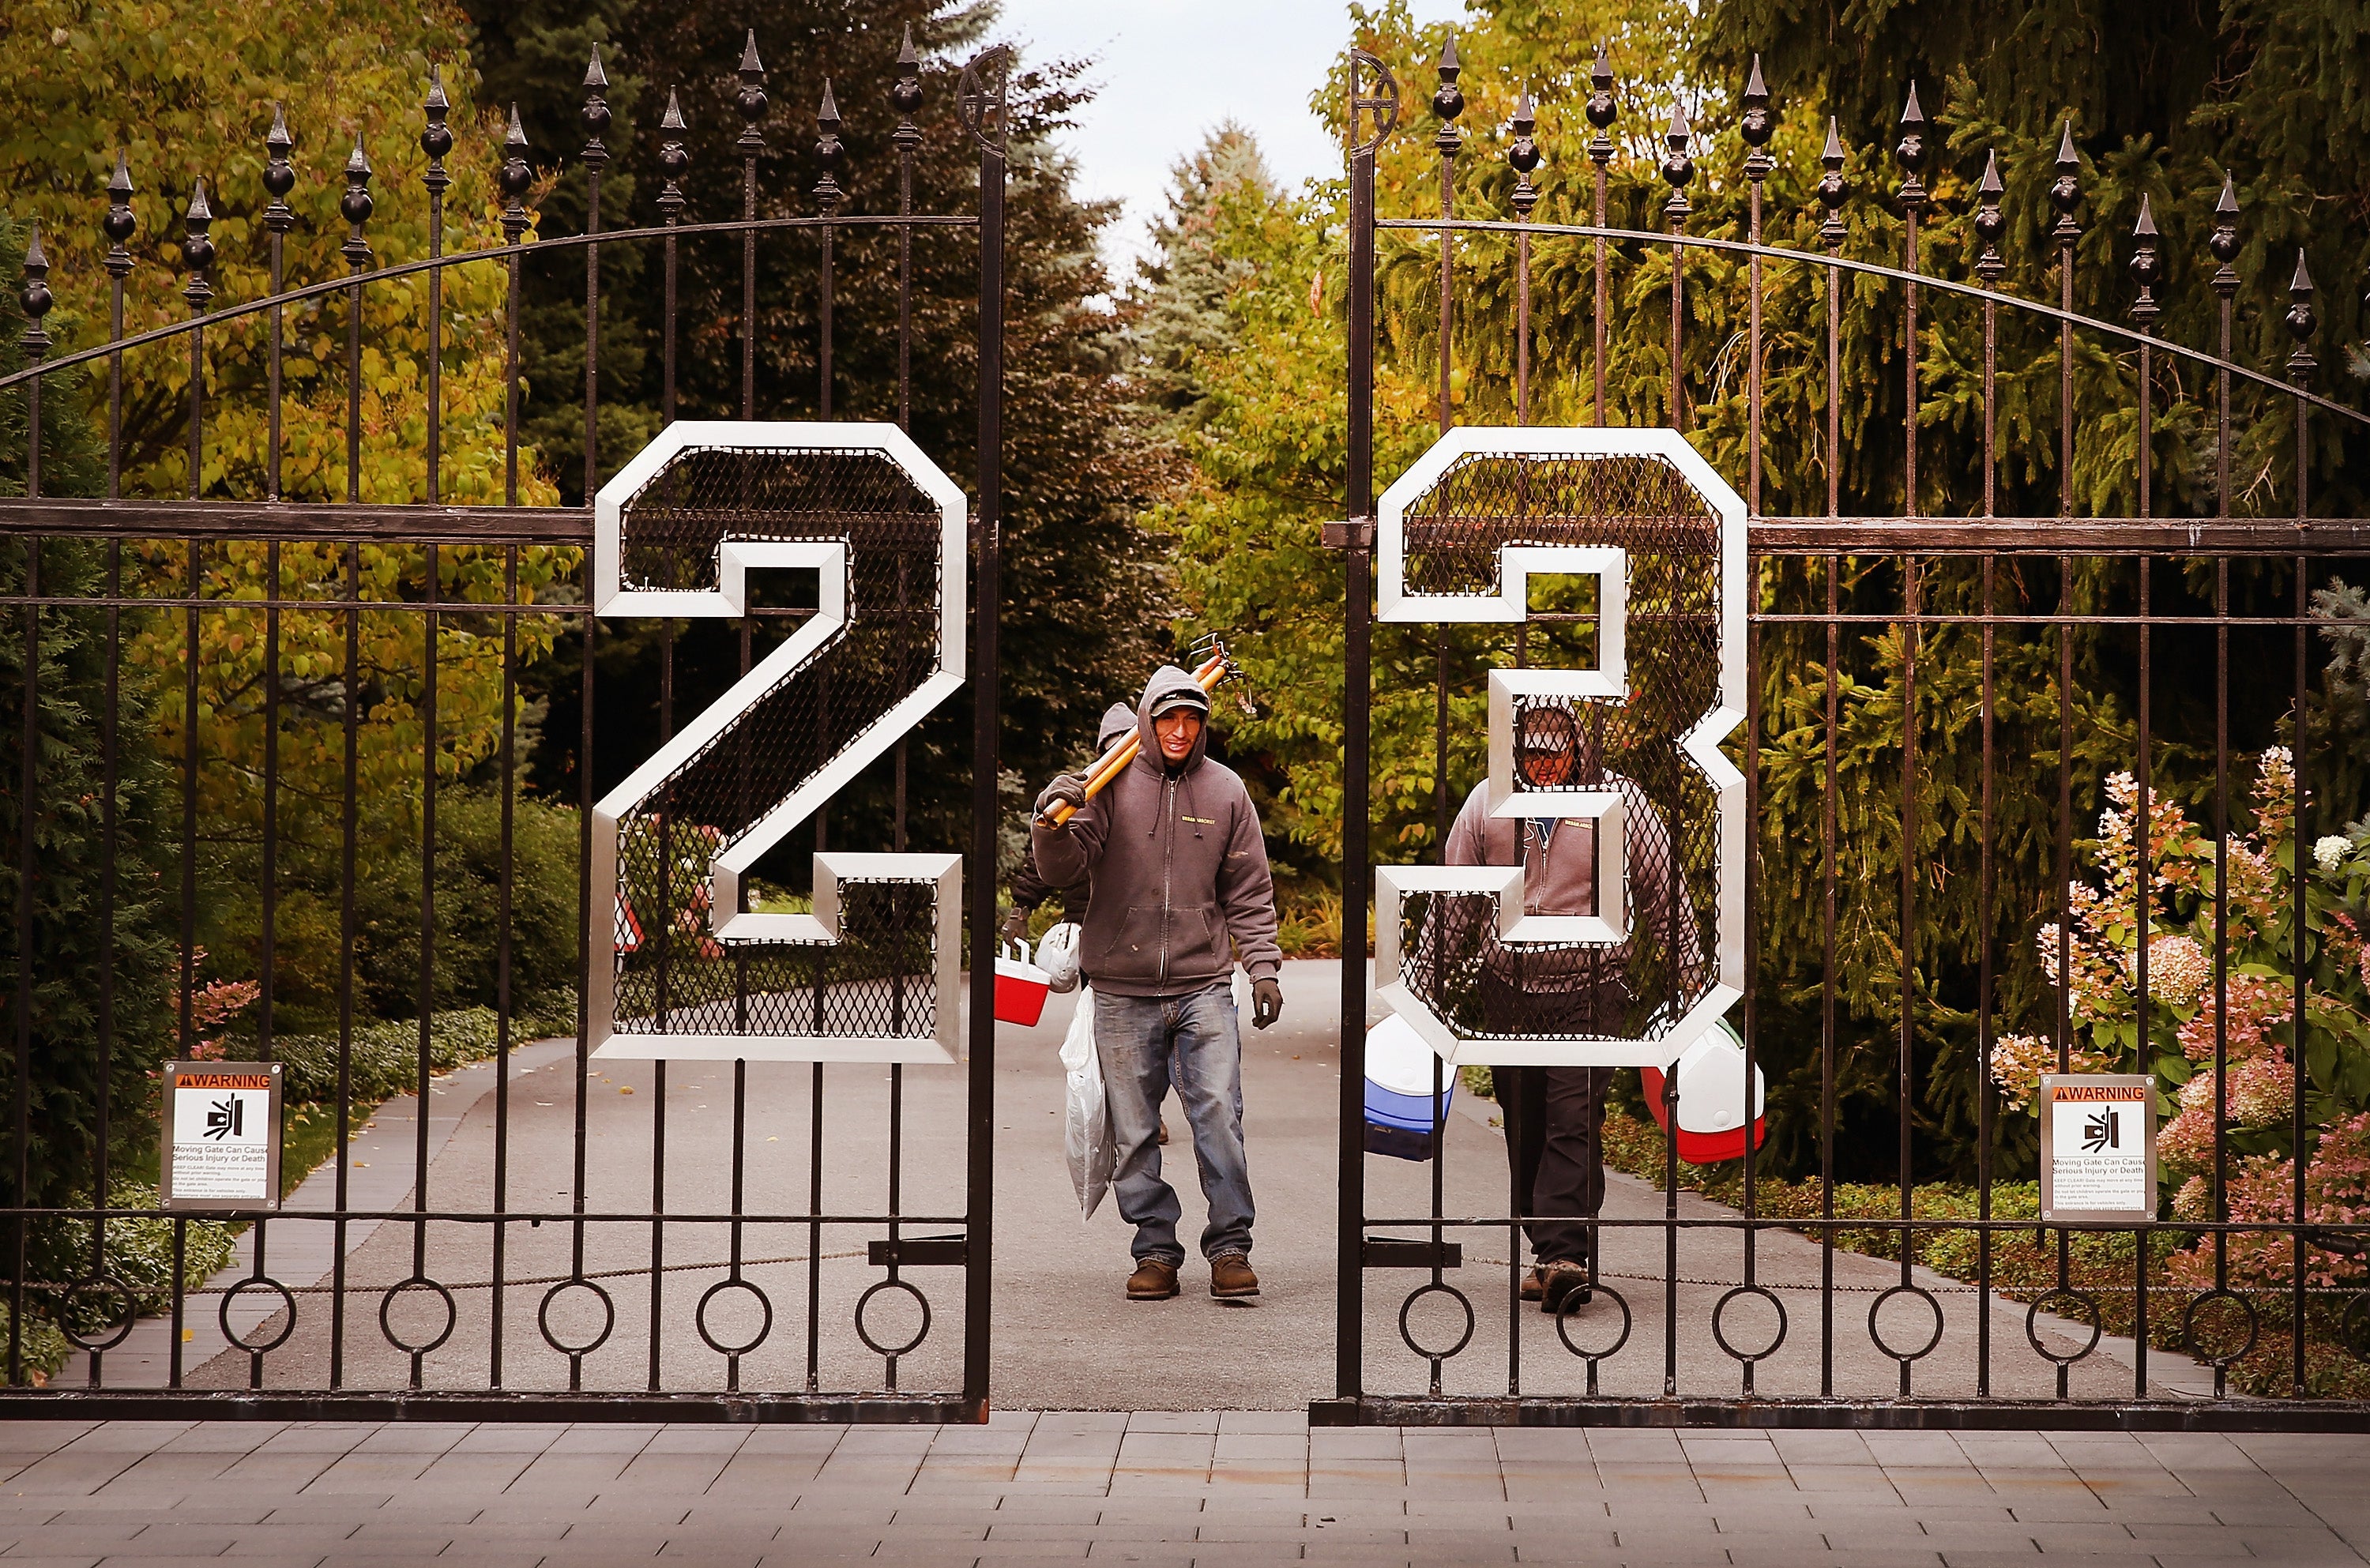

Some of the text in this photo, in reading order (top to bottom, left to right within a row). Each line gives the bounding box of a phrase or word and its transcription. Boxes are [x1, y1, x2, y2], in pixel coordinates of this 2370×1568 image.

[589, 420, 967, 1063] 2
[1375, 427, 1747, 1066] 3
[194, 1075, 270, 1088] WARNING
[2069, 1088, 2144, 1100] WARNING
[173, 1145, 202, 1154] Moving
[205, 1154, 229, 1164] Injury
[2085, 1167, 2108, 1175] Injury
